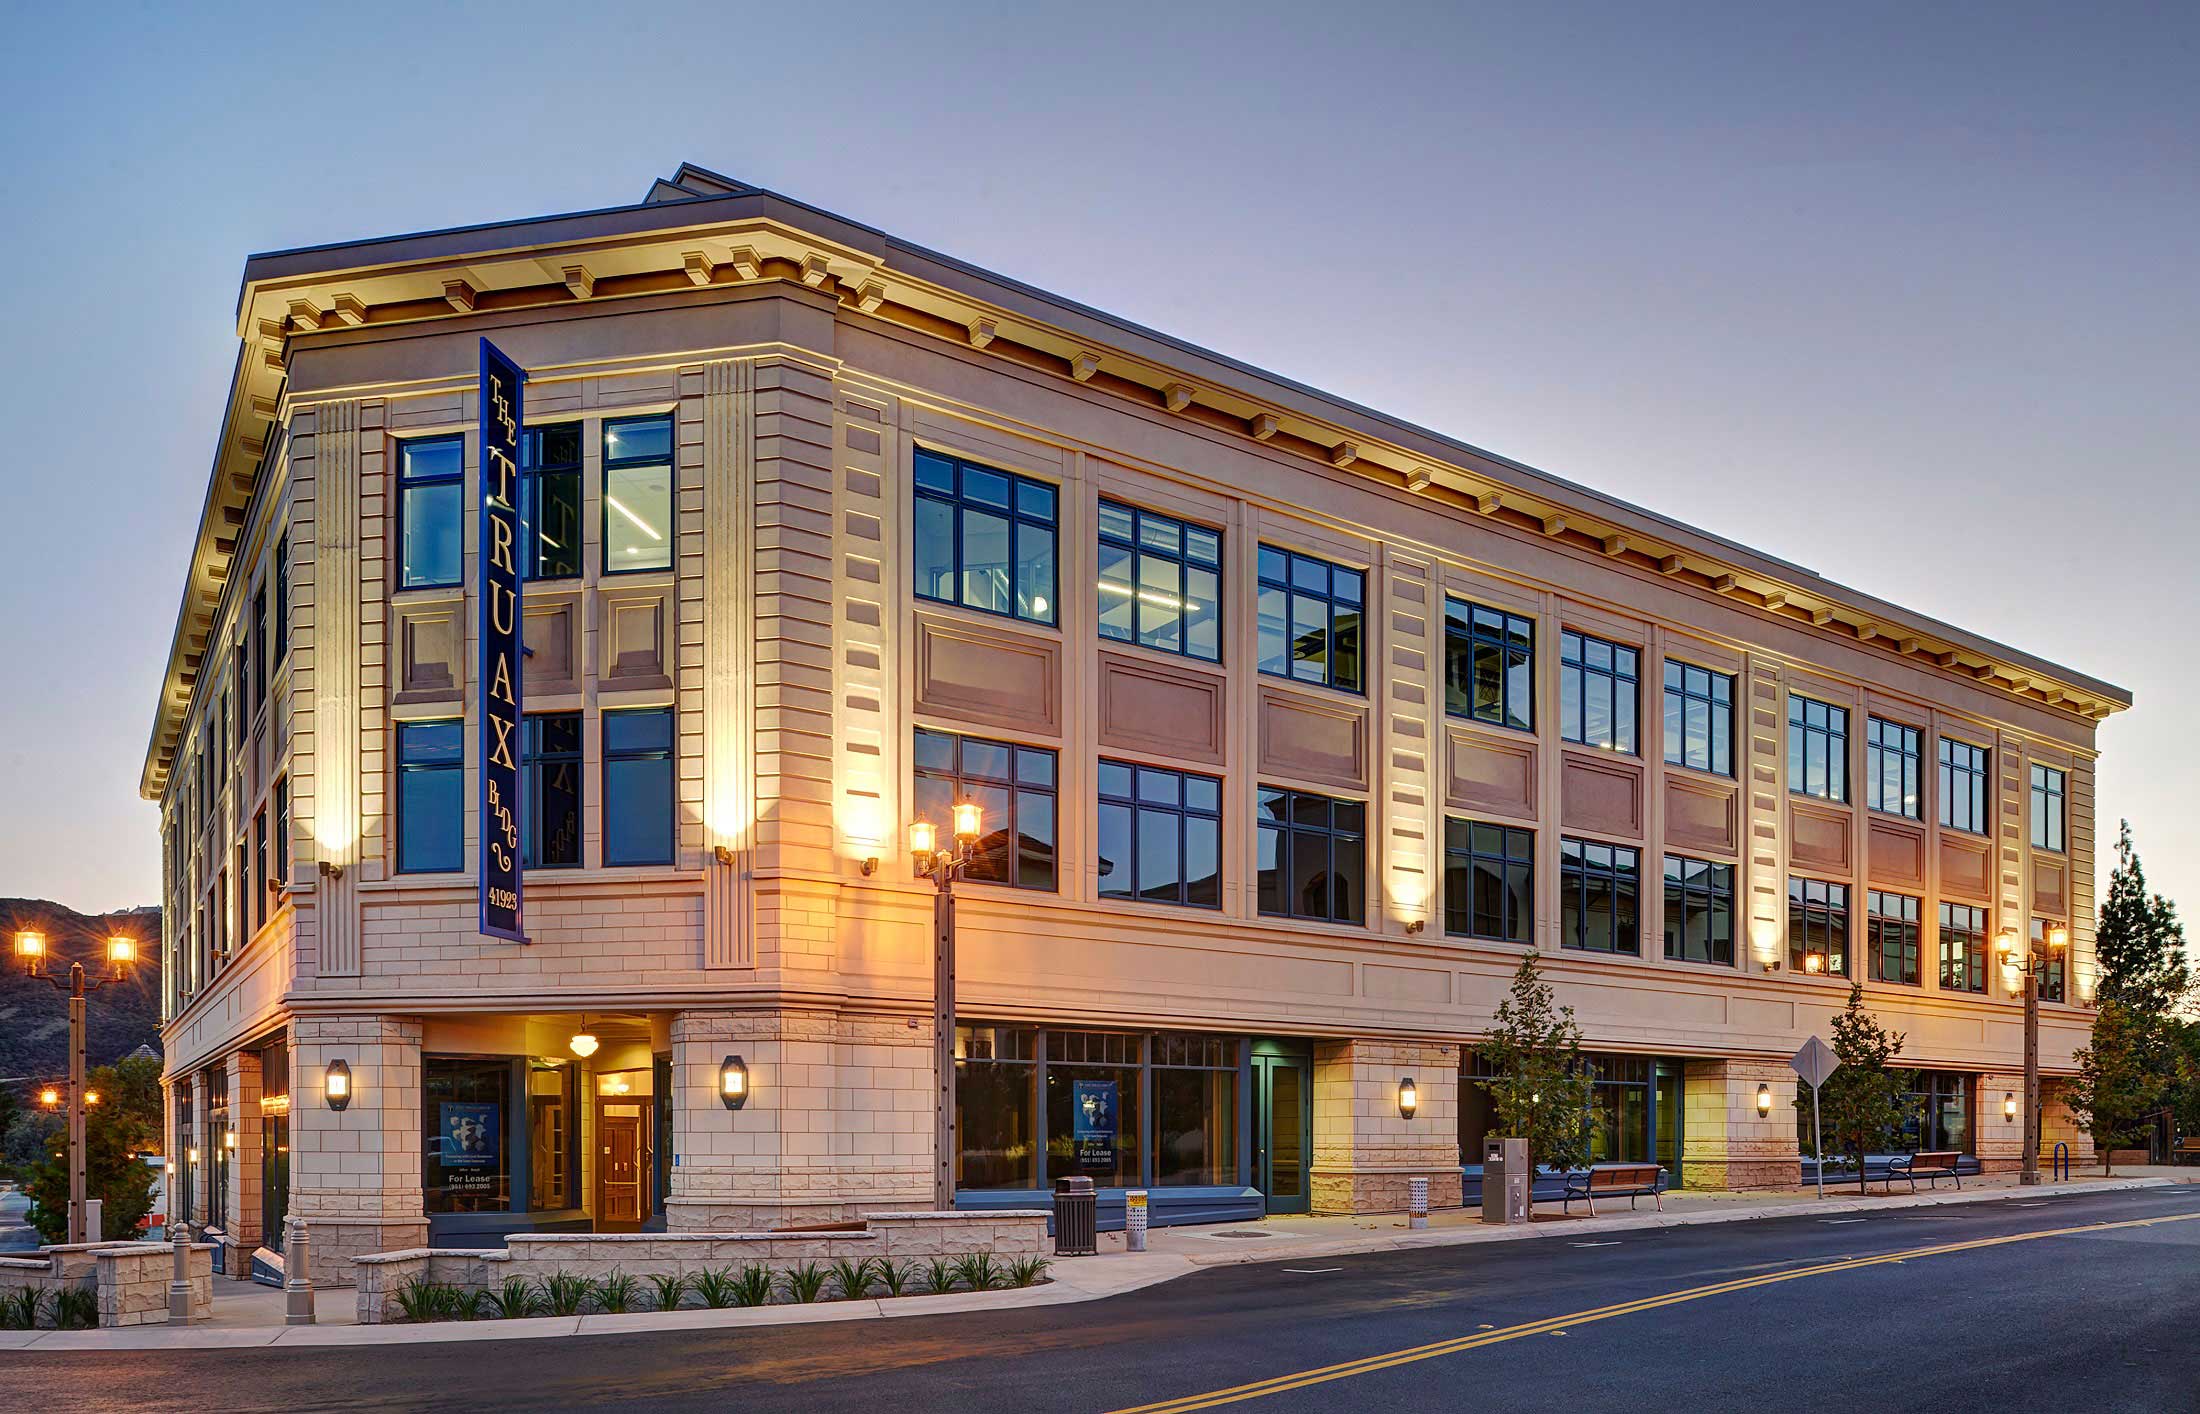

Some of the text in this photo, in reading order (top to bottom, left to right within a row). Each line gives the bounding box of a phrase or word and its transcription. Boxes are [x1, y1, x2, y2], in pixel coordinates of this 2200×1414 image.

[490, 374, 516, 446] THE
[488, 446, 516, 771] TRUAX
[488, 779, 517, 848] BLDG
[489, 887, 517, 910] 41923
[1080, 1149, 1112, 1157] For Lease
